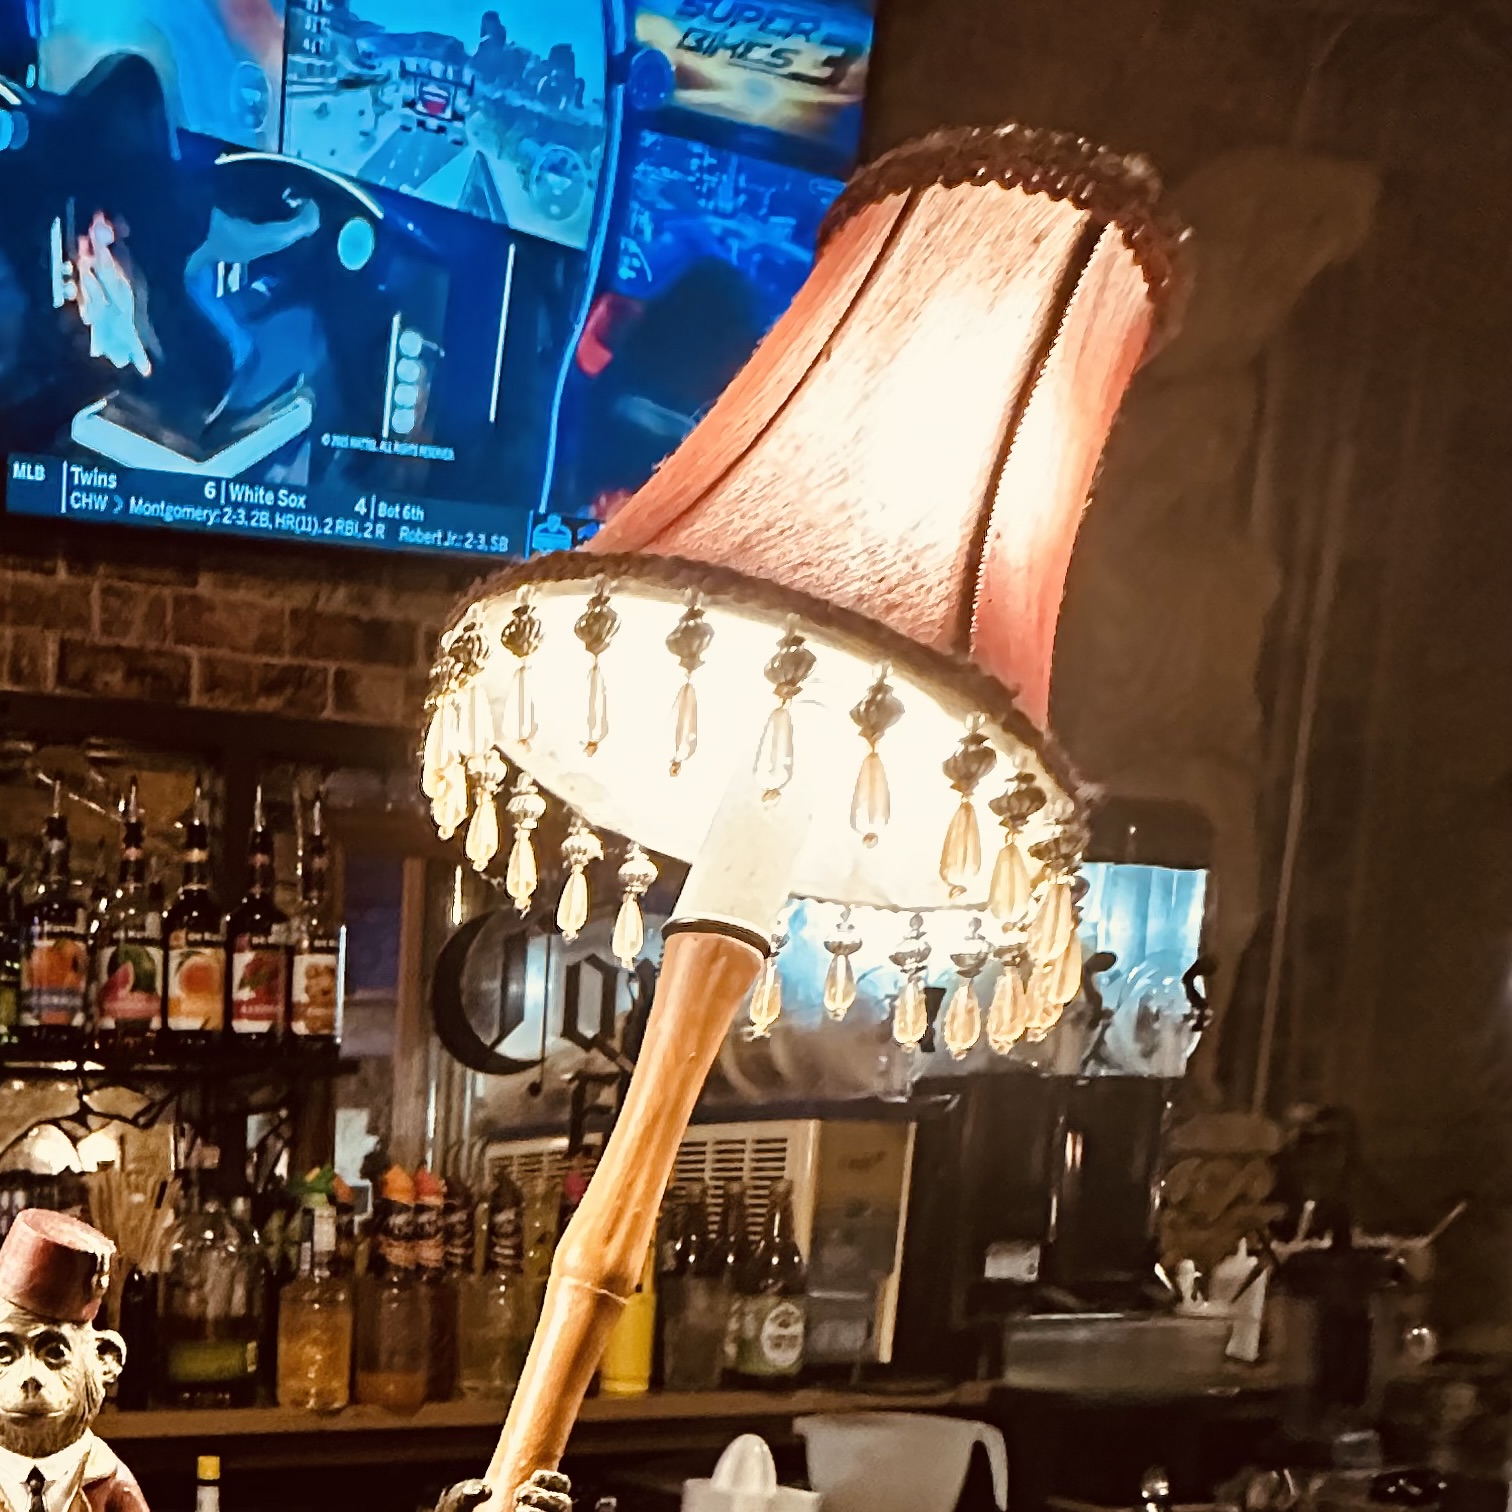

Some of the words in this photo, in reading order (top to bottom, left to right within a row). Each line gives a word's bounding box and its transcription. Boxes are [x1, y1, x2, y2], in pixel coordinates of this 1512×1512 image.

[675, 0, 822, 42] SUPER
[676, 27, 802, 68] BIKES
[12, 460, 46, 481] MLB
[69, 464, 118, 489] Twins
[203, 480, 218, 499] 6
[228, 482, 275, 506] White
[277, 488, 308, 510] Sox
[353, 495, 368, 517] 4
[377, 500, 401, 520] Bot
[402, 503, 425, 523] 6th
[69, 490, 110, 511] CHW
[128, 495, 222, 526] Montgomery:
[322, 516, 334, 535] 2
[363, 522, 373, 540] 2
[374, 522, 386, 540] R
[398, 524, 442, 547] Robert
[490, 533, 510, 553] SB
